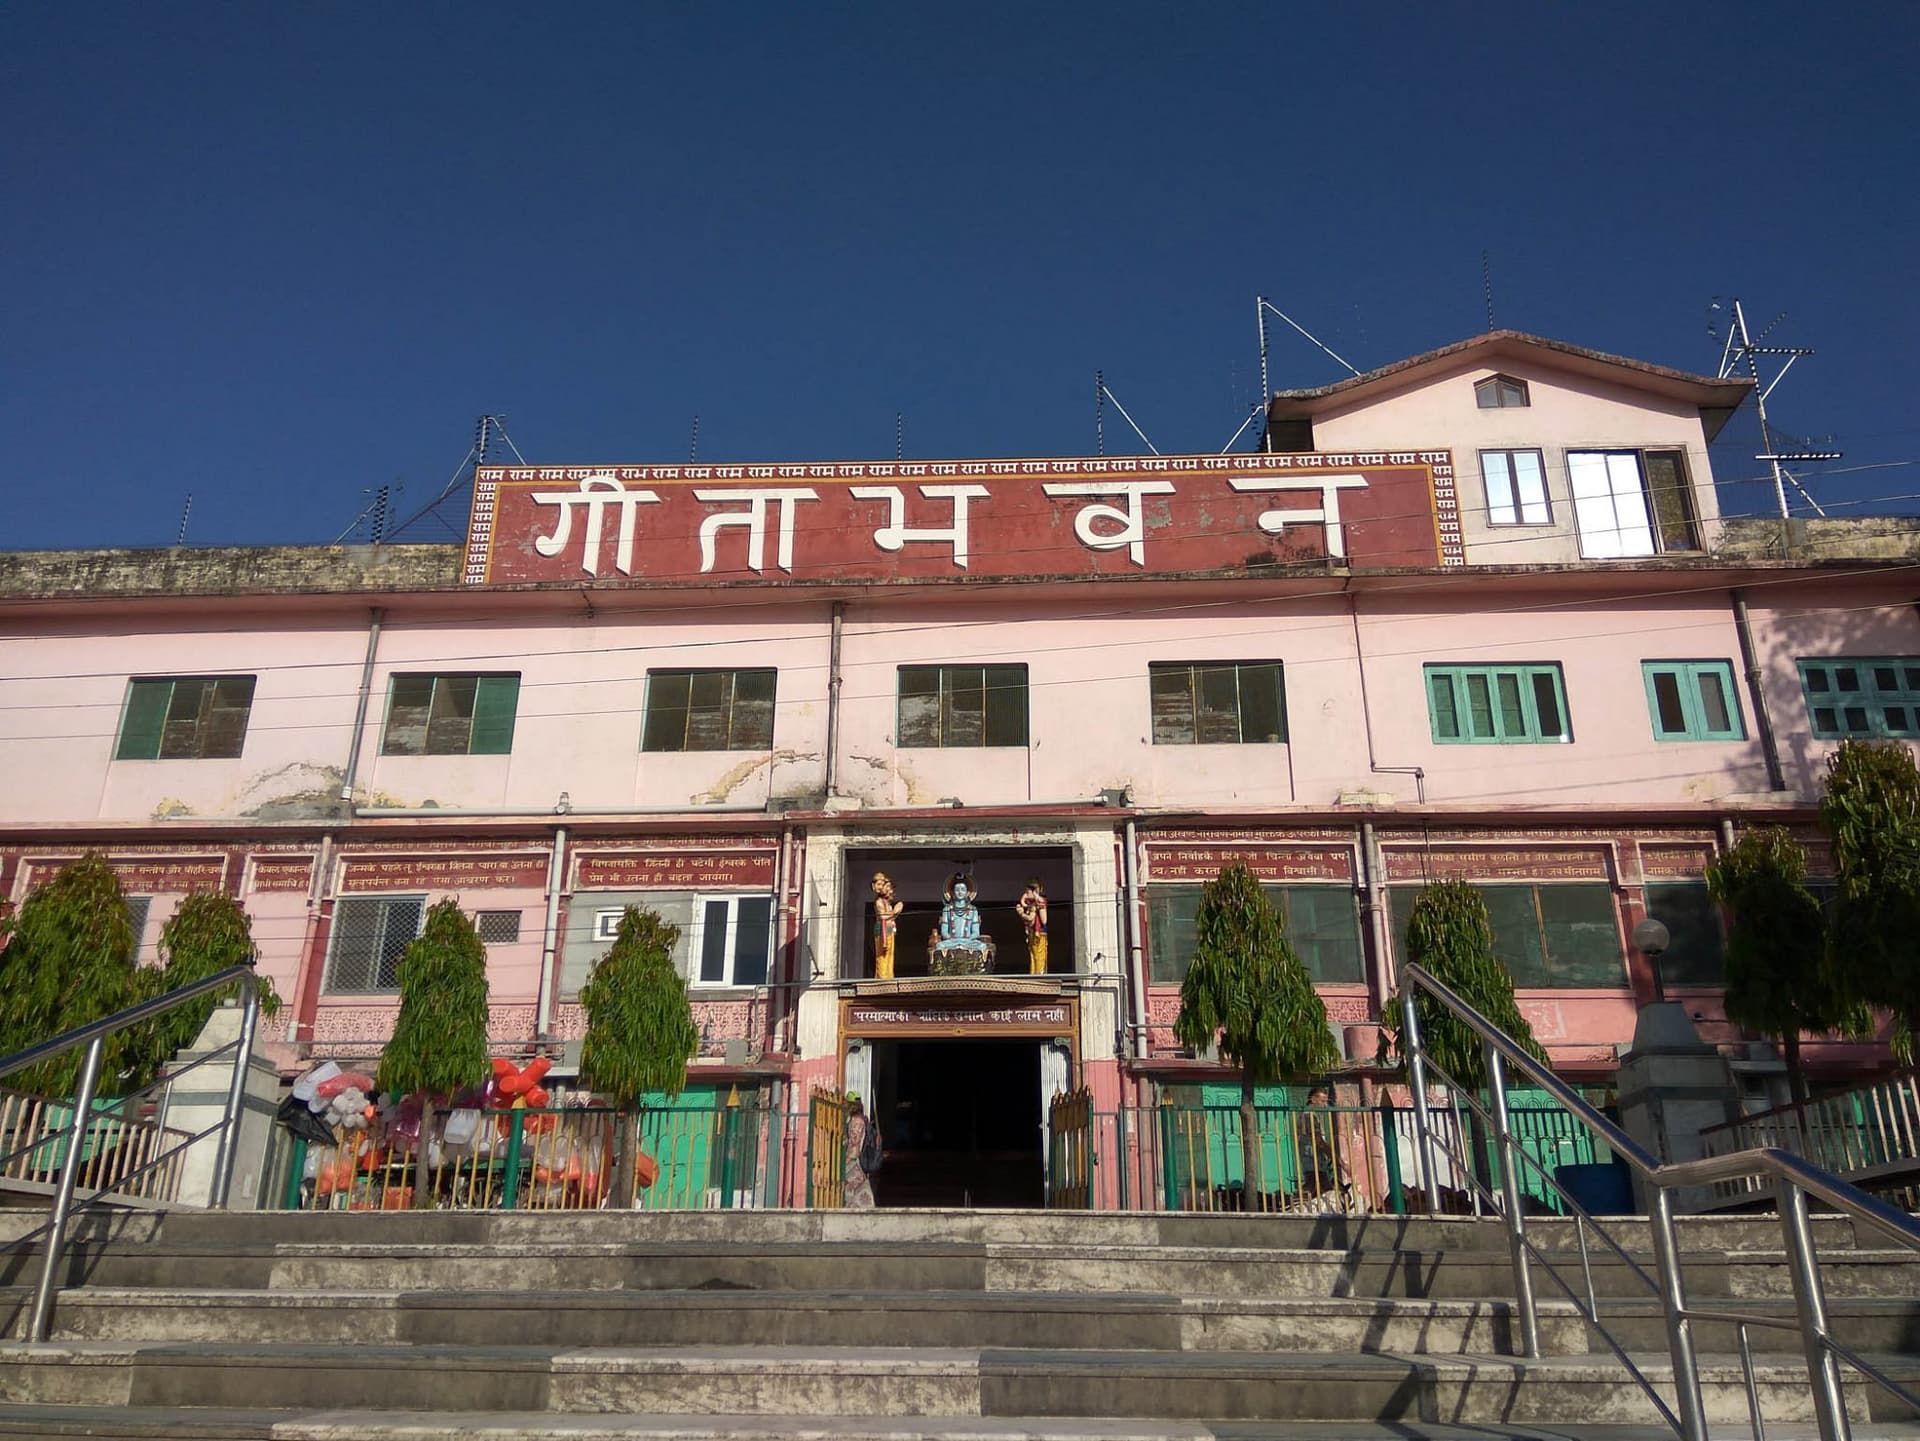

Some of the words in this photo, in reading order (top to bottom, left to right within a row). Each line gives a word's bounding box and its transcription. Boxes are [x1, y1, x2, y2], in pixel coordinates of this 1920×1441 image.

[479, 469, 505, 480] राम
[509, 469, 536, 480] राम
[539, 468, 567, 479] राम
[567, 468, 593, 479] राम
[652, 466, 680, 477] राम
[685, 466, 712, 477] राम
[716, 466, 744, 477] राम
[748, 465, 776, 476] राम
[779, 465, 807, 476] राम
[810, 465, 835, 476] राम
[839, 464, 865, 475] राम
[869, 464, 895, 475] राम
[899, 463, 928, 474] राम
[931, 463, 958, 474] राम
[961, 462, 989, 473] राम
[990, 461, 1019, 472] राम
[1022, 461, 1048, 472] राम
[1052, 460, 1079, 471] राम
[1080, 459, 1108, 470] राम
[1111, 459, 1137, 470] राम
[1140, 458, 1169, 469] राम
[1172, 457, 1198, 468] राम
[1202, 457, 1230, 468] राम
[1234, 456, 1261, 467] राम
[1264, 456, 1293, 467] राम
[1296, 455, 1323, 466] राम
[1327, 454, 1354, 465] राम
[1357, 454, 1386, 465] राम
[1389, 453, 1415, 464] राम
[1420, 452, 1448, 463] राम
[1433, 466, 1451, 475] राम
[478, 482, 496, 491] राम
[1434, 478, 1453, 486] राम
[477, 492, 495, 501] राम
[1436, 489, 1454, 498] राम
[476, 502, 494, 511] राम
[1437, 500, 1456, 508] राम
[474, 513, 492, 521] राम
[1438, 512, 1457, 520] राम
[472, 523, 491, 532] राम
[531, 473, 820, 576] गीता
[849, 474, 1369, 567] भवन
[1440, 523, 1458, 531] राम
[472, 533, 490, 542] राम
[1440, 534, 1460, 543] राम
[470, 544, 488, 552] राम
[1442, 546, 1462, 554] राम
[469, 554, 487, 563] राम
[1444, 557, 1463, 566] राम
[467, 564, 486, 574] राम
[465, 576, 484, 584] राम
